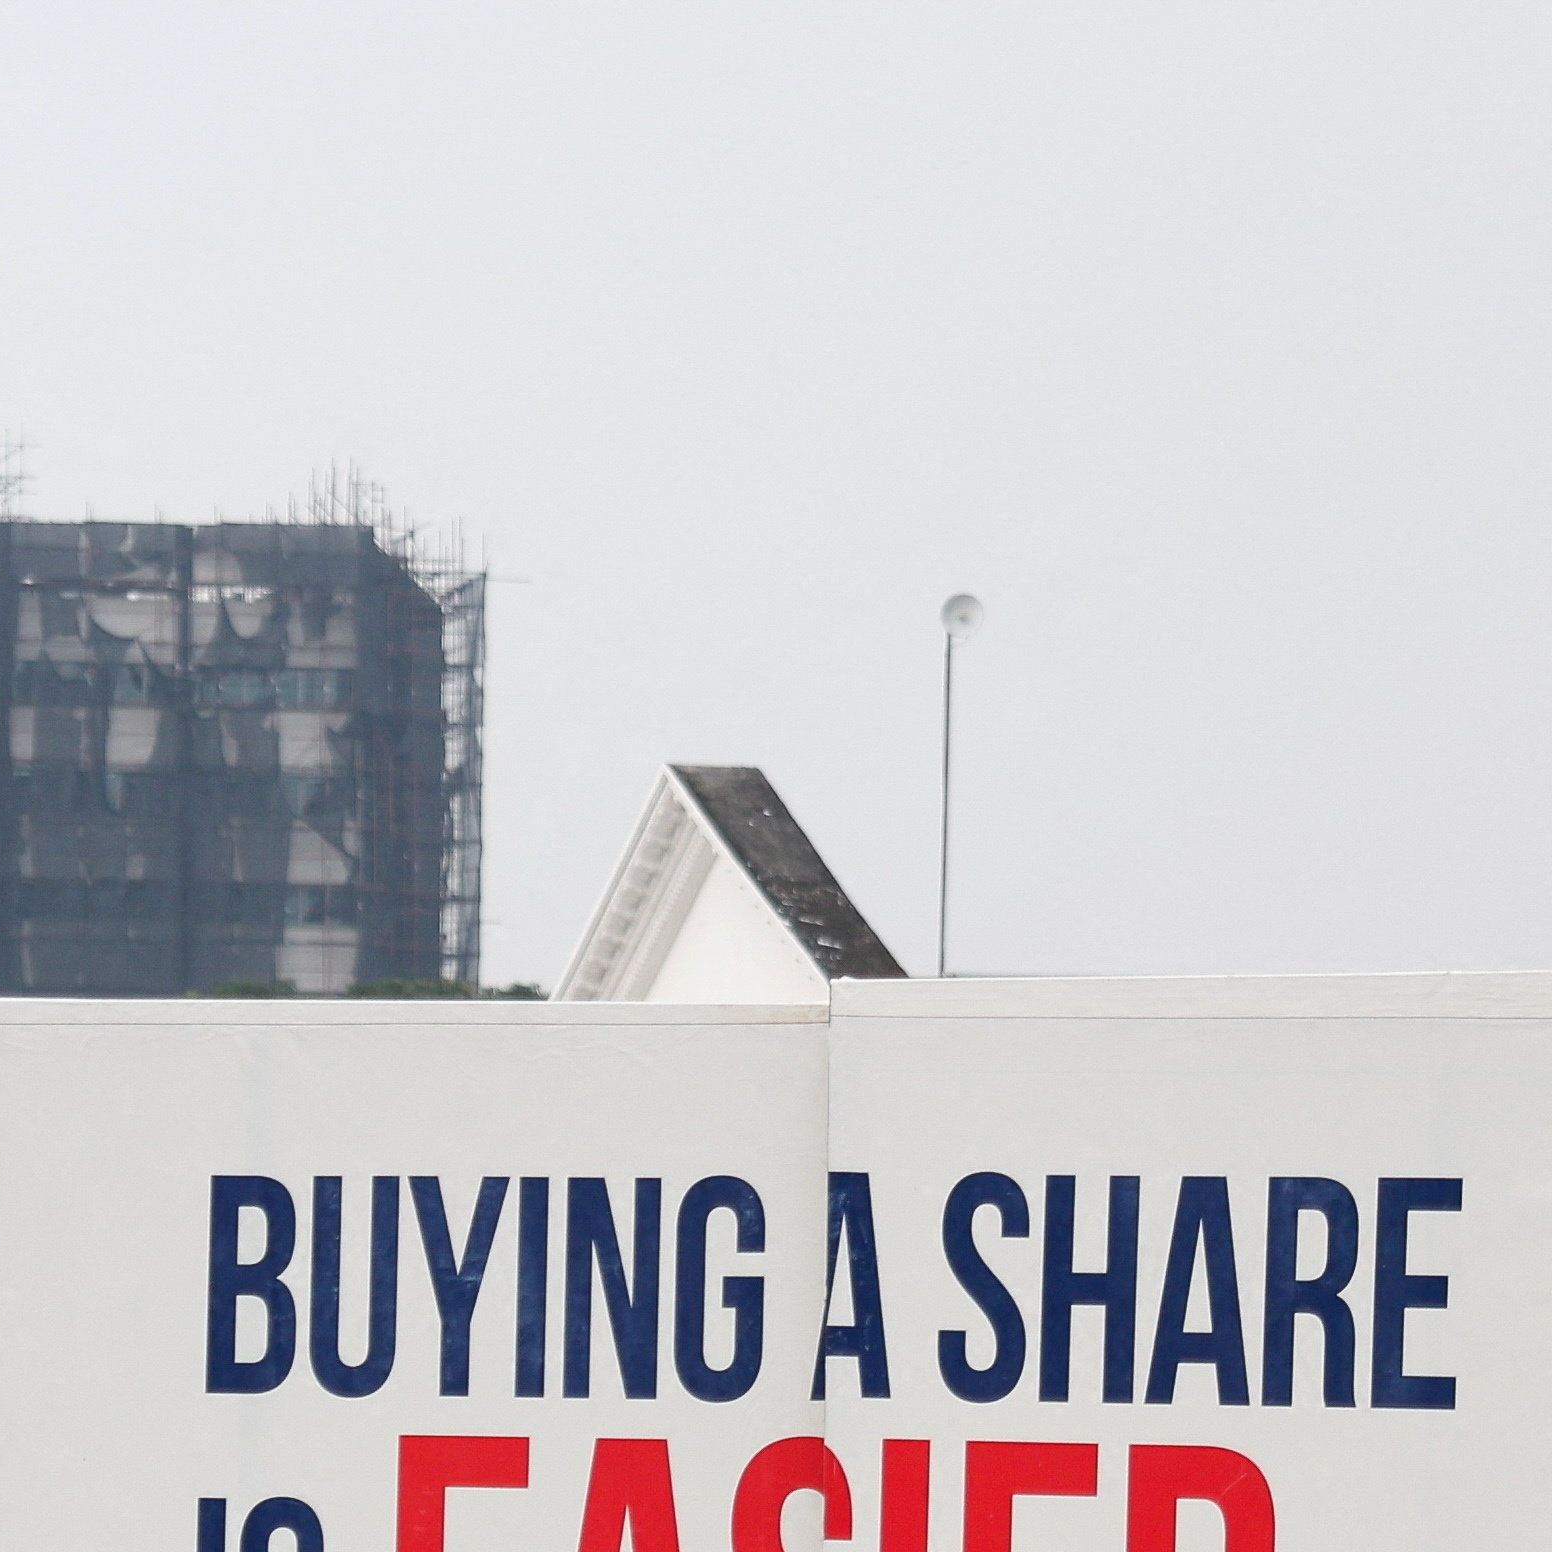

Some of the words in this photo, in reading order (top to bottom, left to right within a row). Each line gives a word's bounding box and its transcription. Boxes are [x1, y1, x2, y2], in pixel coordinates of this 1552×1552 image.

[205, 1174, 766, 1403] BUYING
[810, 1171, 891, 1401] A
[937, 1171, 1464, 1410] SHARE
